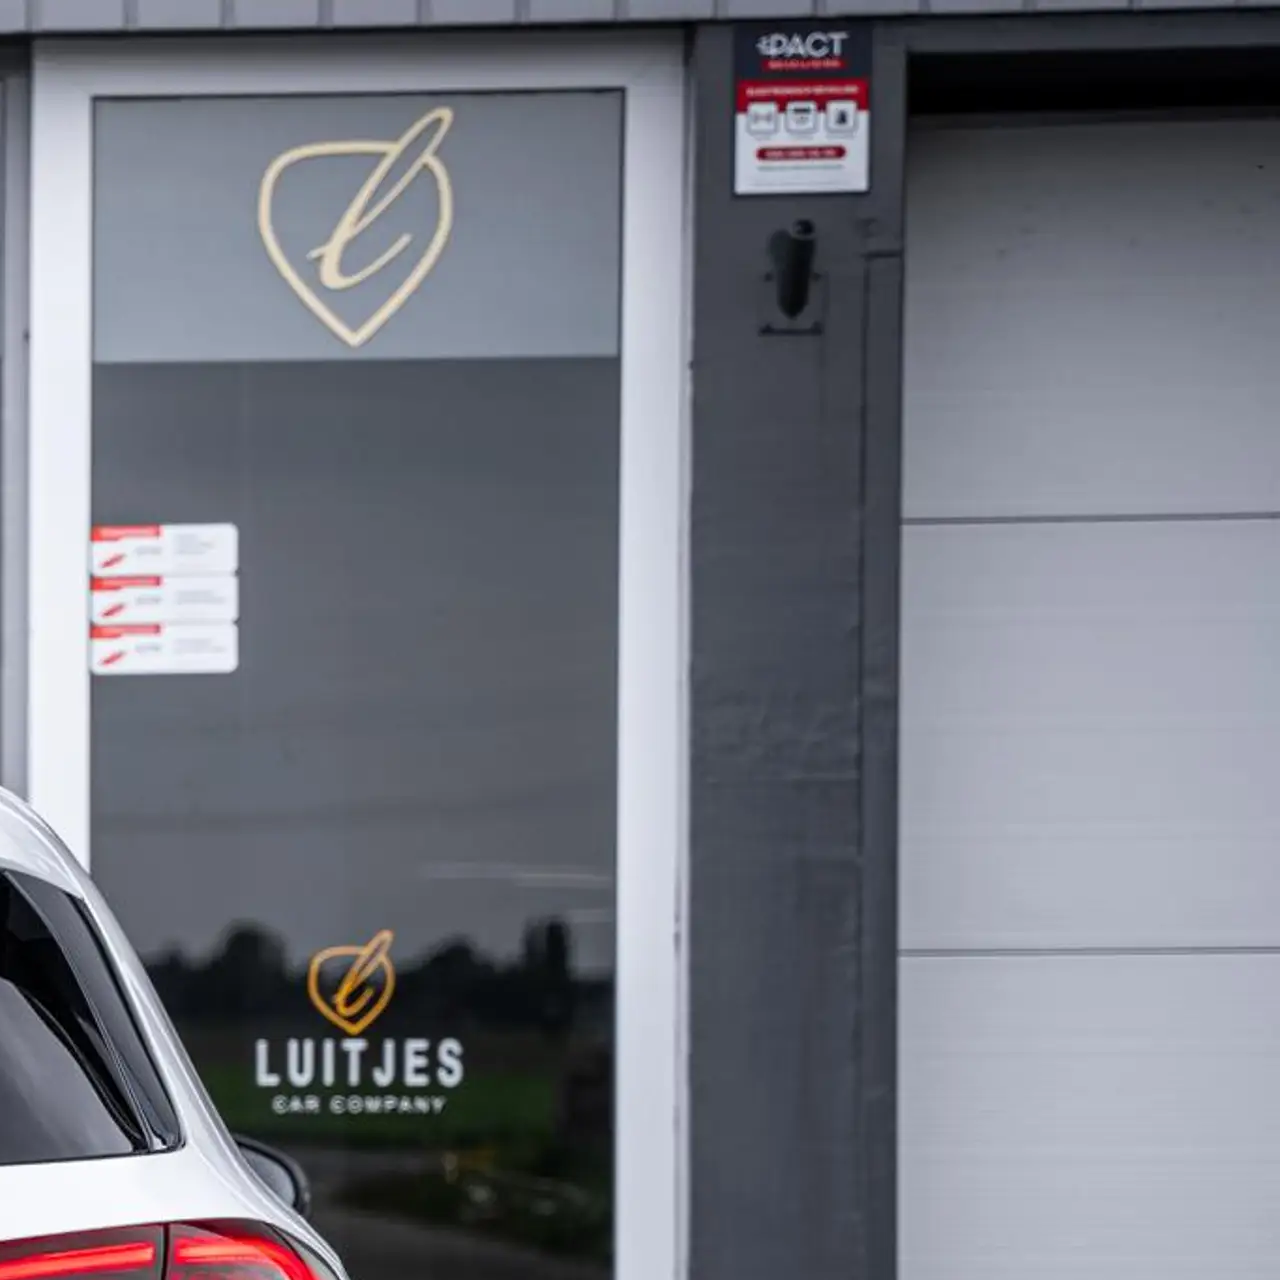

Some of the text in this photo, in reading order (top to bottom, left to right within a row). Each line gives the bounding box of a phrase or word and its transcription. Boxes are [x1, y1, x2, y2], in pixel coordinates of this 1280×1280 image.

[255, 1037, 464, 1088] LUITJES
[272, 1094, 448, 1114] CAR COMPANY
